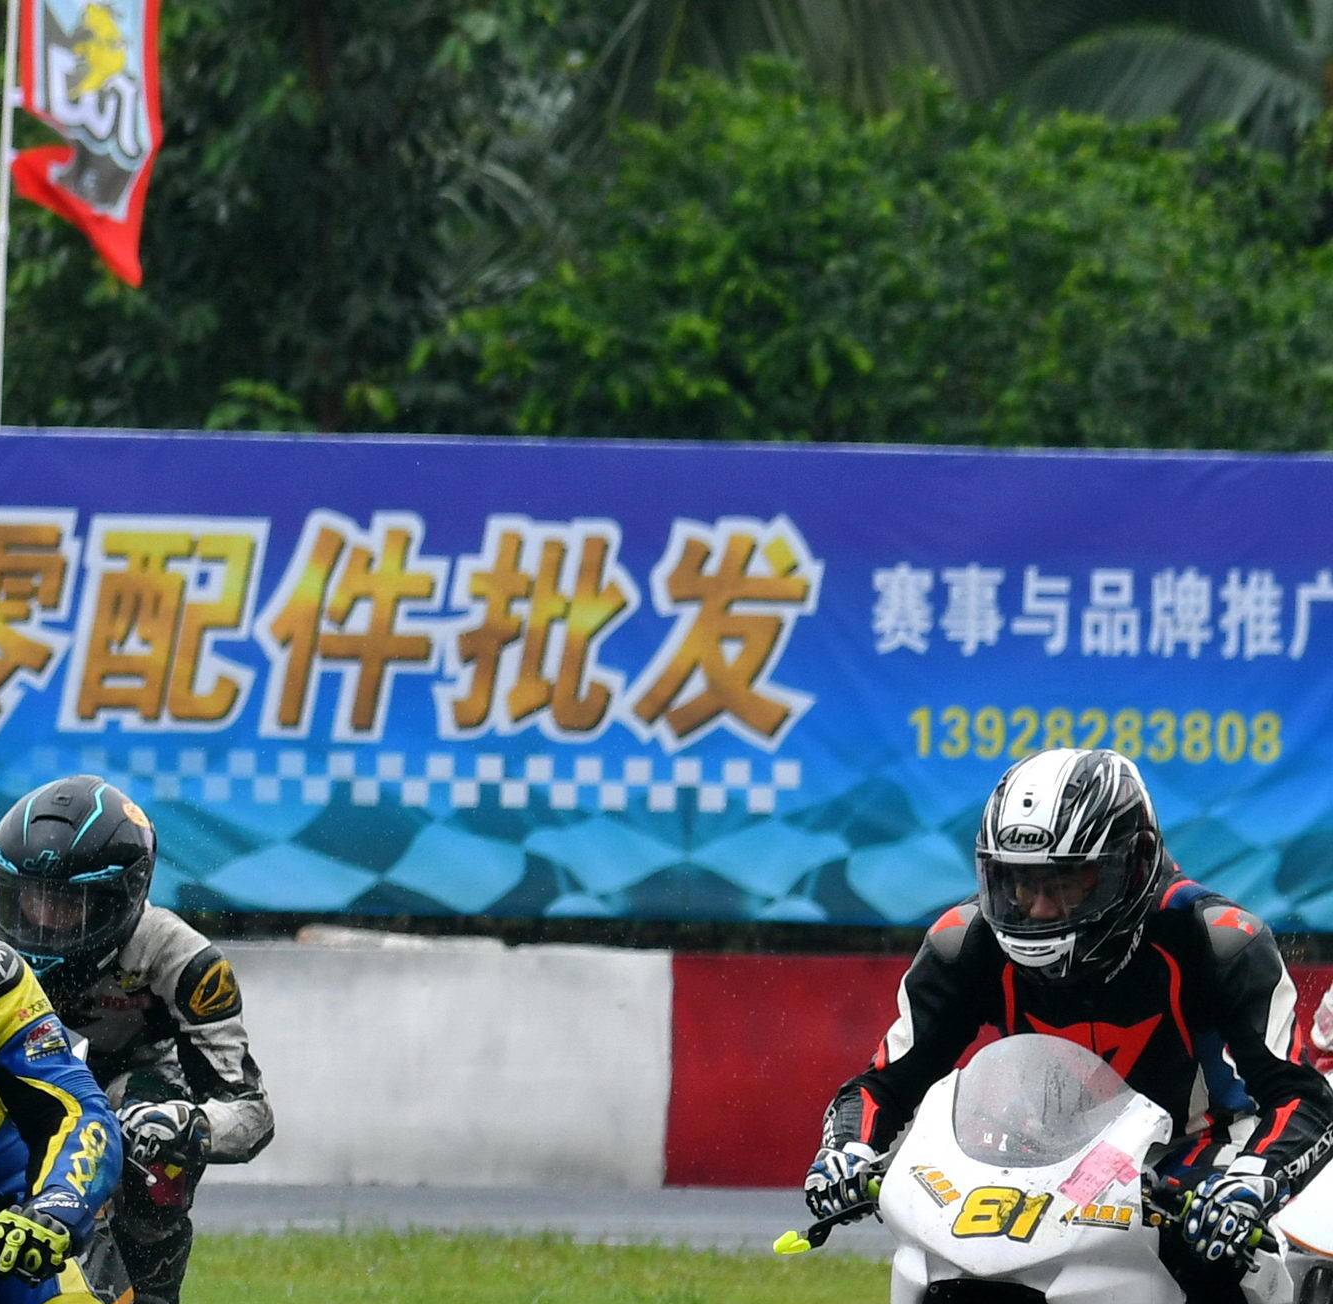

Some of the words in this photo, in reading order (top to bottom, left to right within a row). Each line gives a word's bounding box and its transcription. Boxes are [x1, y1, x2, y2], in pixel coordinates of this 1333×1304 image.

[873, 562, 1333, 658] 赛事与品牌推广
[909, 705, 1283, 764] 13928283808
[1002, 827, 1045, 845] Arai
[951, 1186, 1054, 1243] 81
